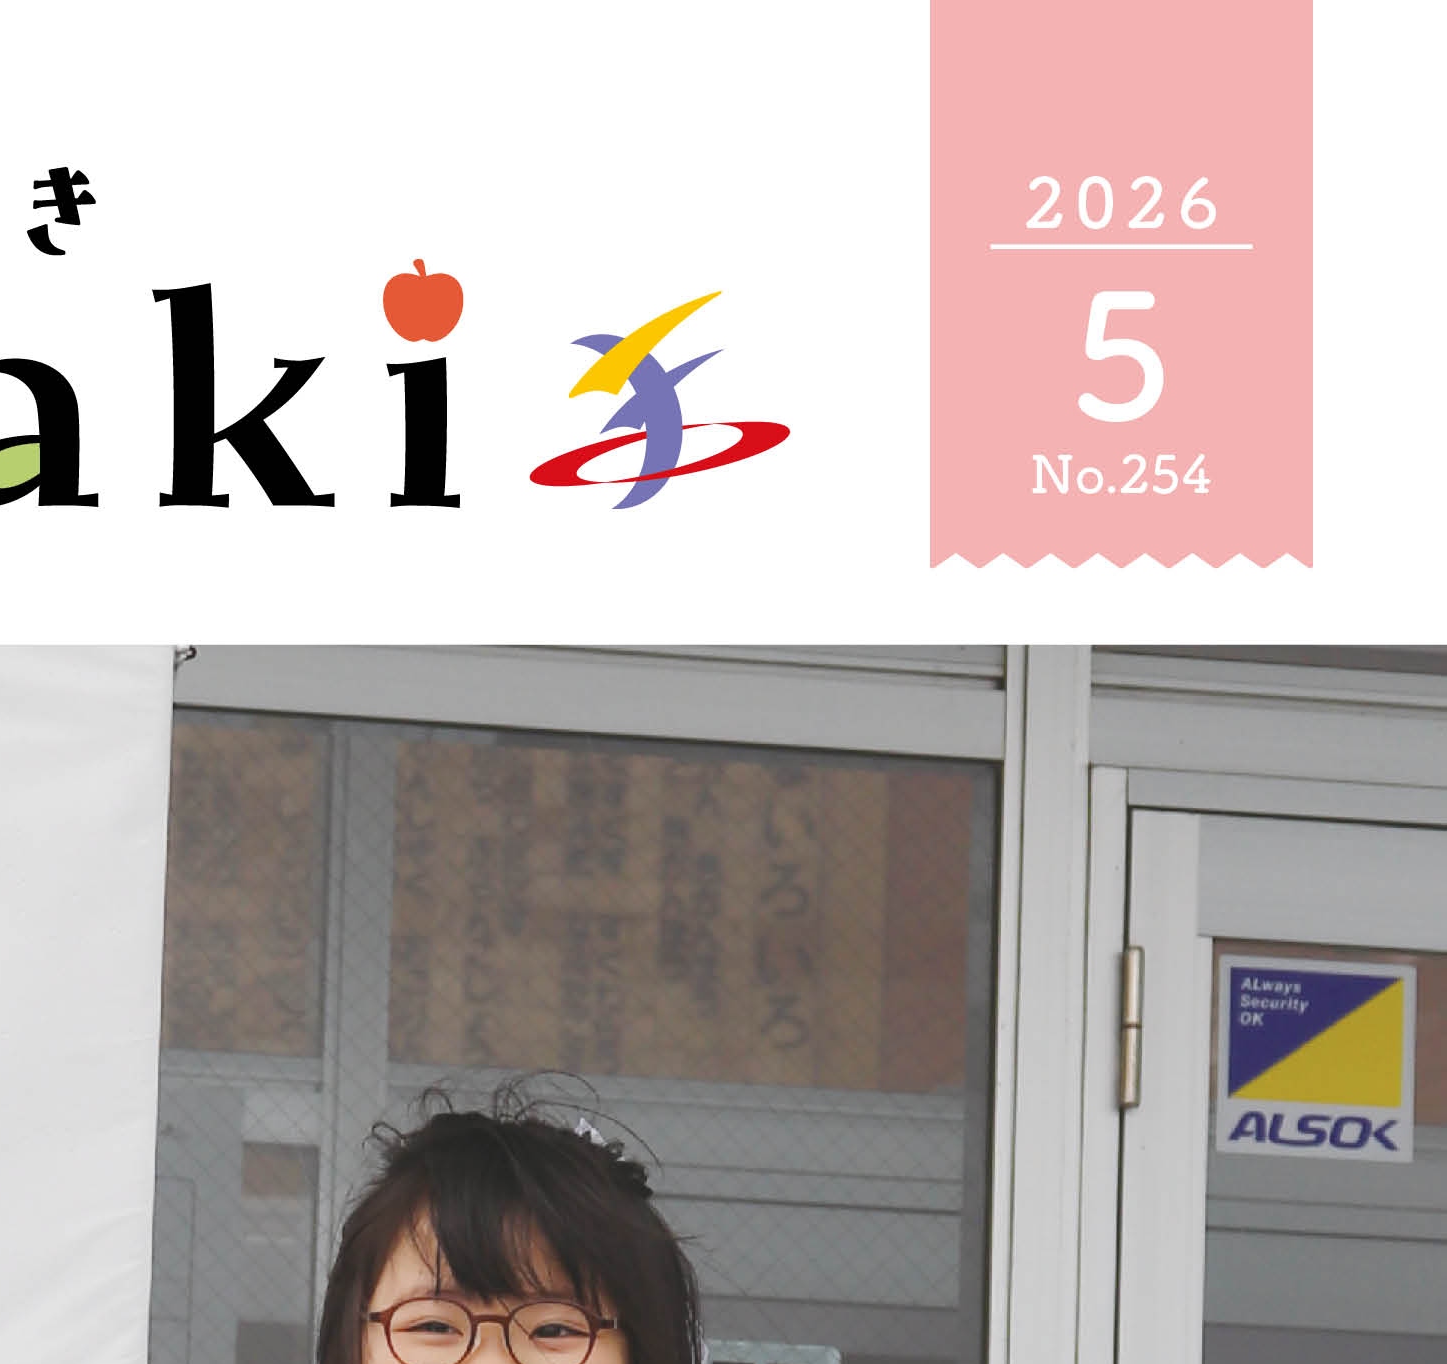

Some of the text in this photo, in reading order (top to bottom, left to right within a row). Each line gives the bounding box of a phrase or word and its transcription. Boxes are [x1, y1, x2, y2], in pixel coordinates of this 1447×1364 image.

[1240, 995, 1309, 1014] Security
[1239, 1012, 1265, 1026] OK
[1227, 1110, 1400, 1152] ALSOK
